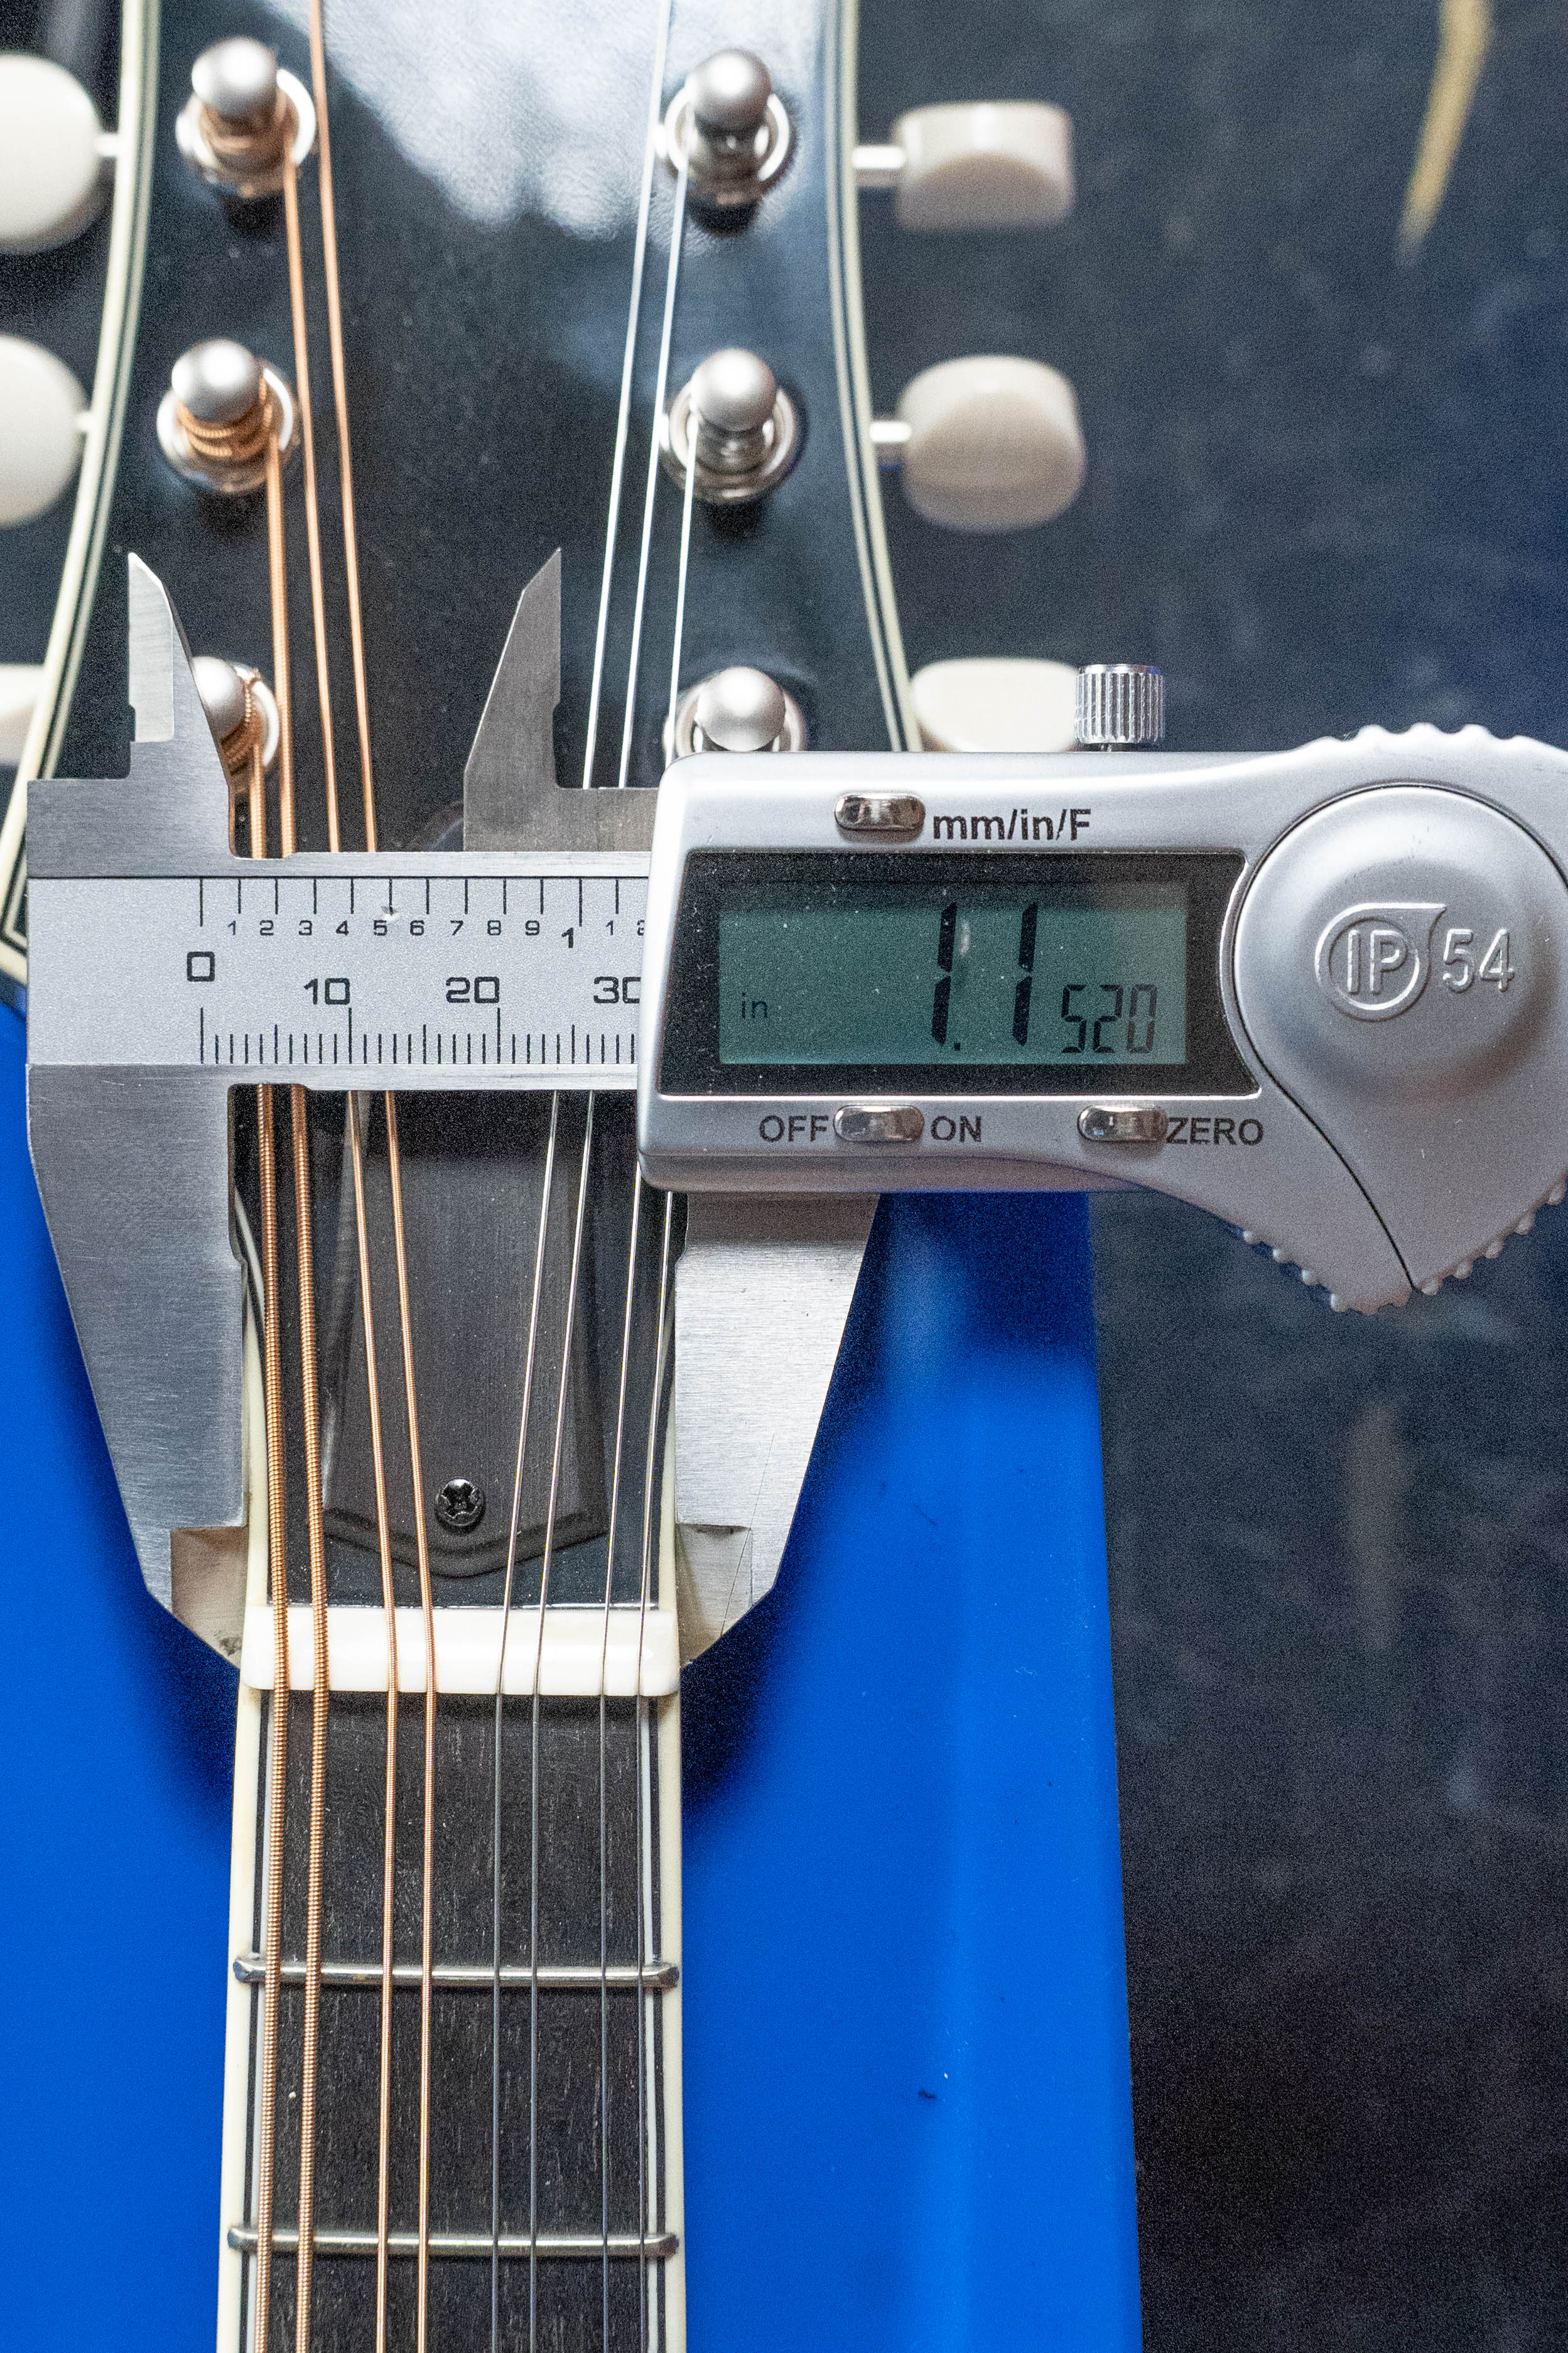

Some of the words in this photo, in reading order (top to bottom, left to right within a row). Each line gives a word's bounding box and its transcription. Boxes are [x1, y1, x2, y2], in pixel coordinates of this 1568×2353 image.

[933, 808, 1091, 840] mm/in/F
[228, 920, 236, 935] 1
[260, 920, 274, 936] 2
[298, 920, 313, 936] 3
[336, 920, 349, 935] 4
[374, 920, 387, 936] 5
[410, 920, 425, 936] 6
[450, 920, 463, 935] 7
[487, 920, 501, 936] 8
[525, 920, 540, 936] 9
[561, 928, 574, 948] 1
[606, 921, 614, 935] 1
[187, 952, 215, 982] 0
[1348, 930, 1408, 995] IP
[1443, 928, 1515, 994] 54
[304, 978, 350, 1005] 10
[446, 977, 500, 1004] 20
[593, 977, 641, 1004] 30
[740, 992, 769, 1019] in
[759, 1116, 829, 1142] OFF
[930, 1116, 982, 1142] ON
[1165, 1117, 1264, 1146] ZERO
